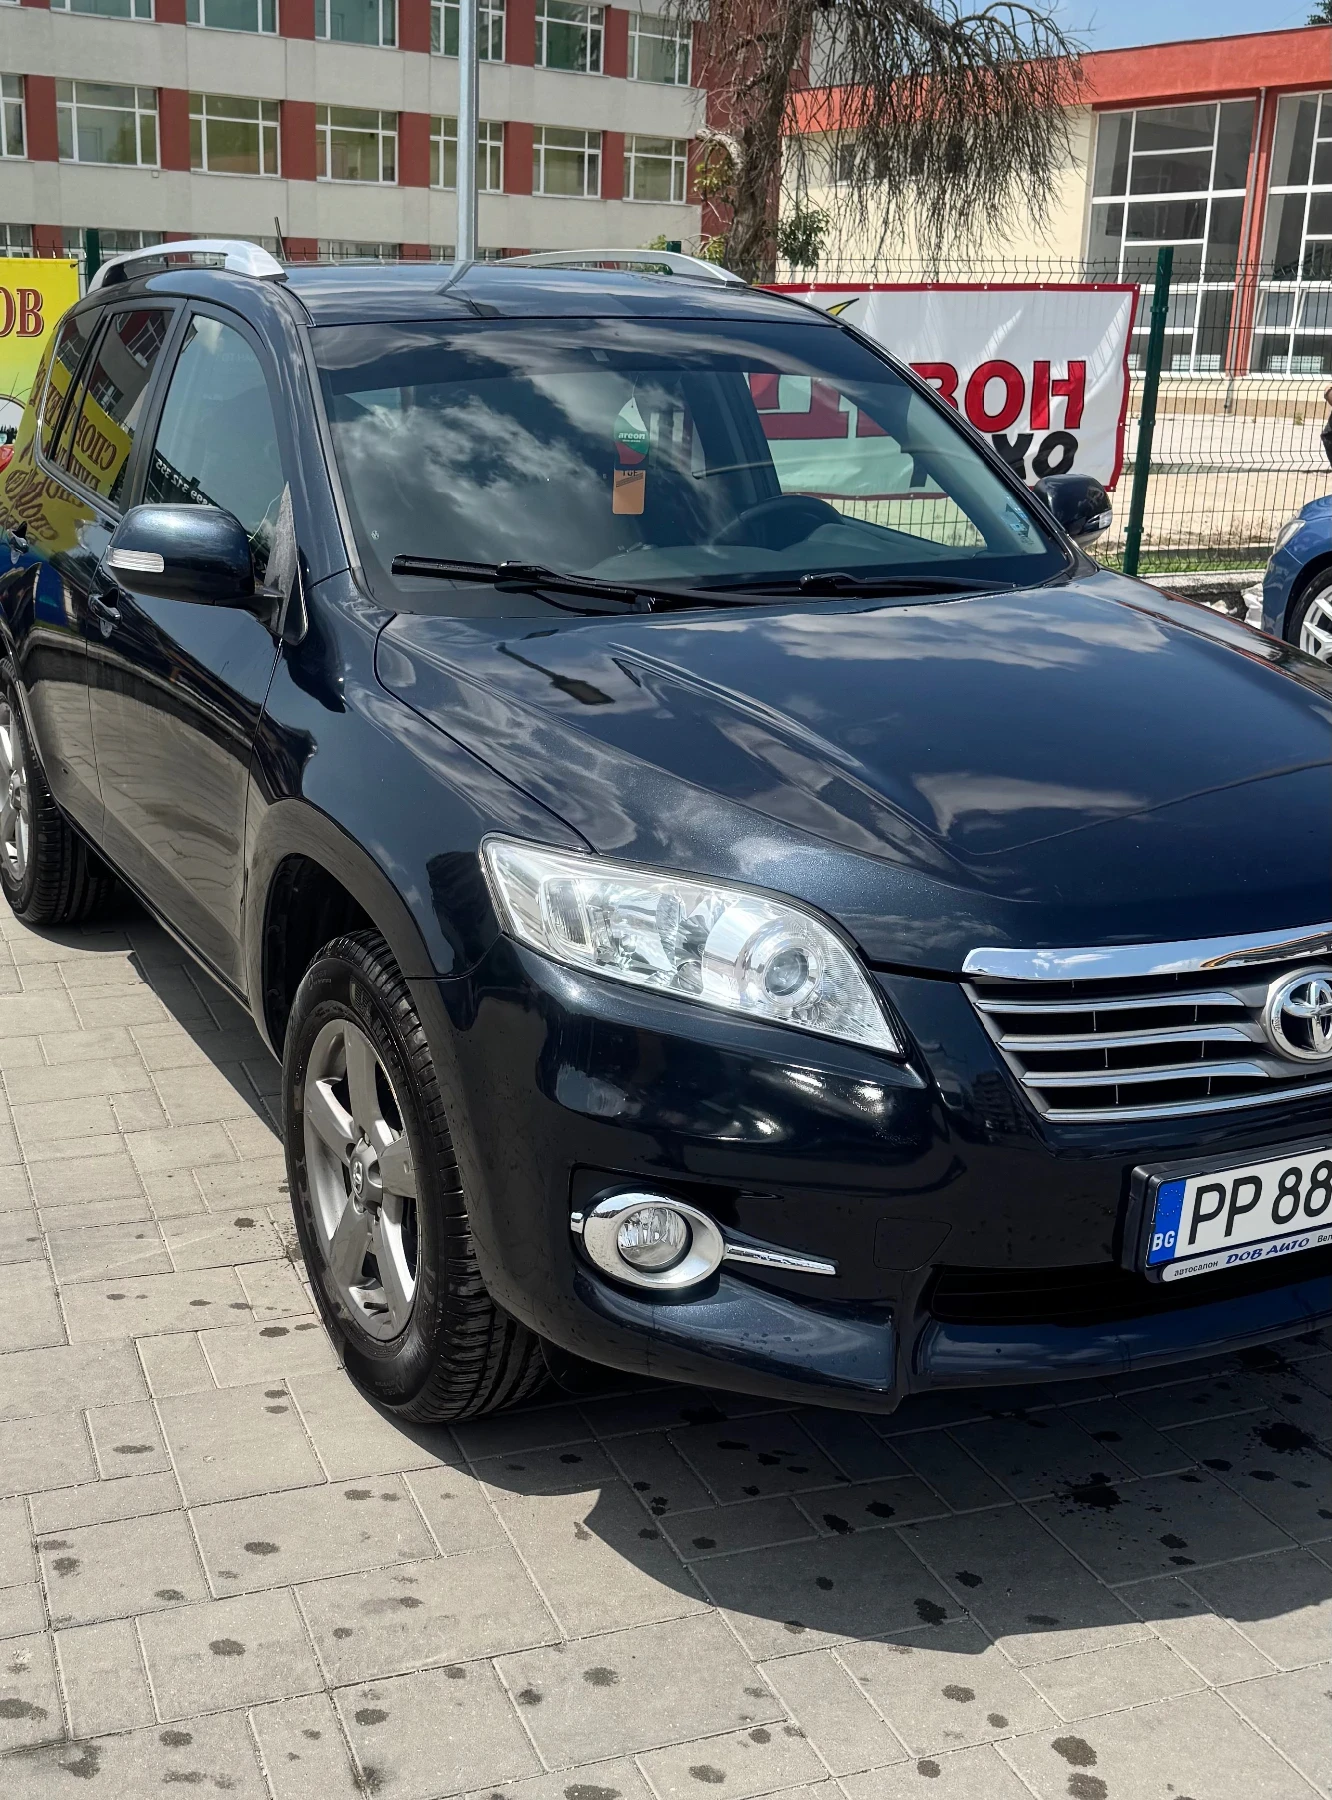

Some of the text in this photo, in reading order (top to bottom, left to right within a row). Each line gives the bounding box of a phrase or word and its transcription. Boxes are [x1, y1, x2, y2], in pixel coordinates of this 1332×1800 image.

[618, 431, 646, 439] areon
[1188, 1159, 1332, 1246] PP 88
[1151, 1230, 1176, 1252] BG
[1225, 1237, 1311, 1265] DOB AUTO
[1173, 1260, 1219, 1277] автосалон
